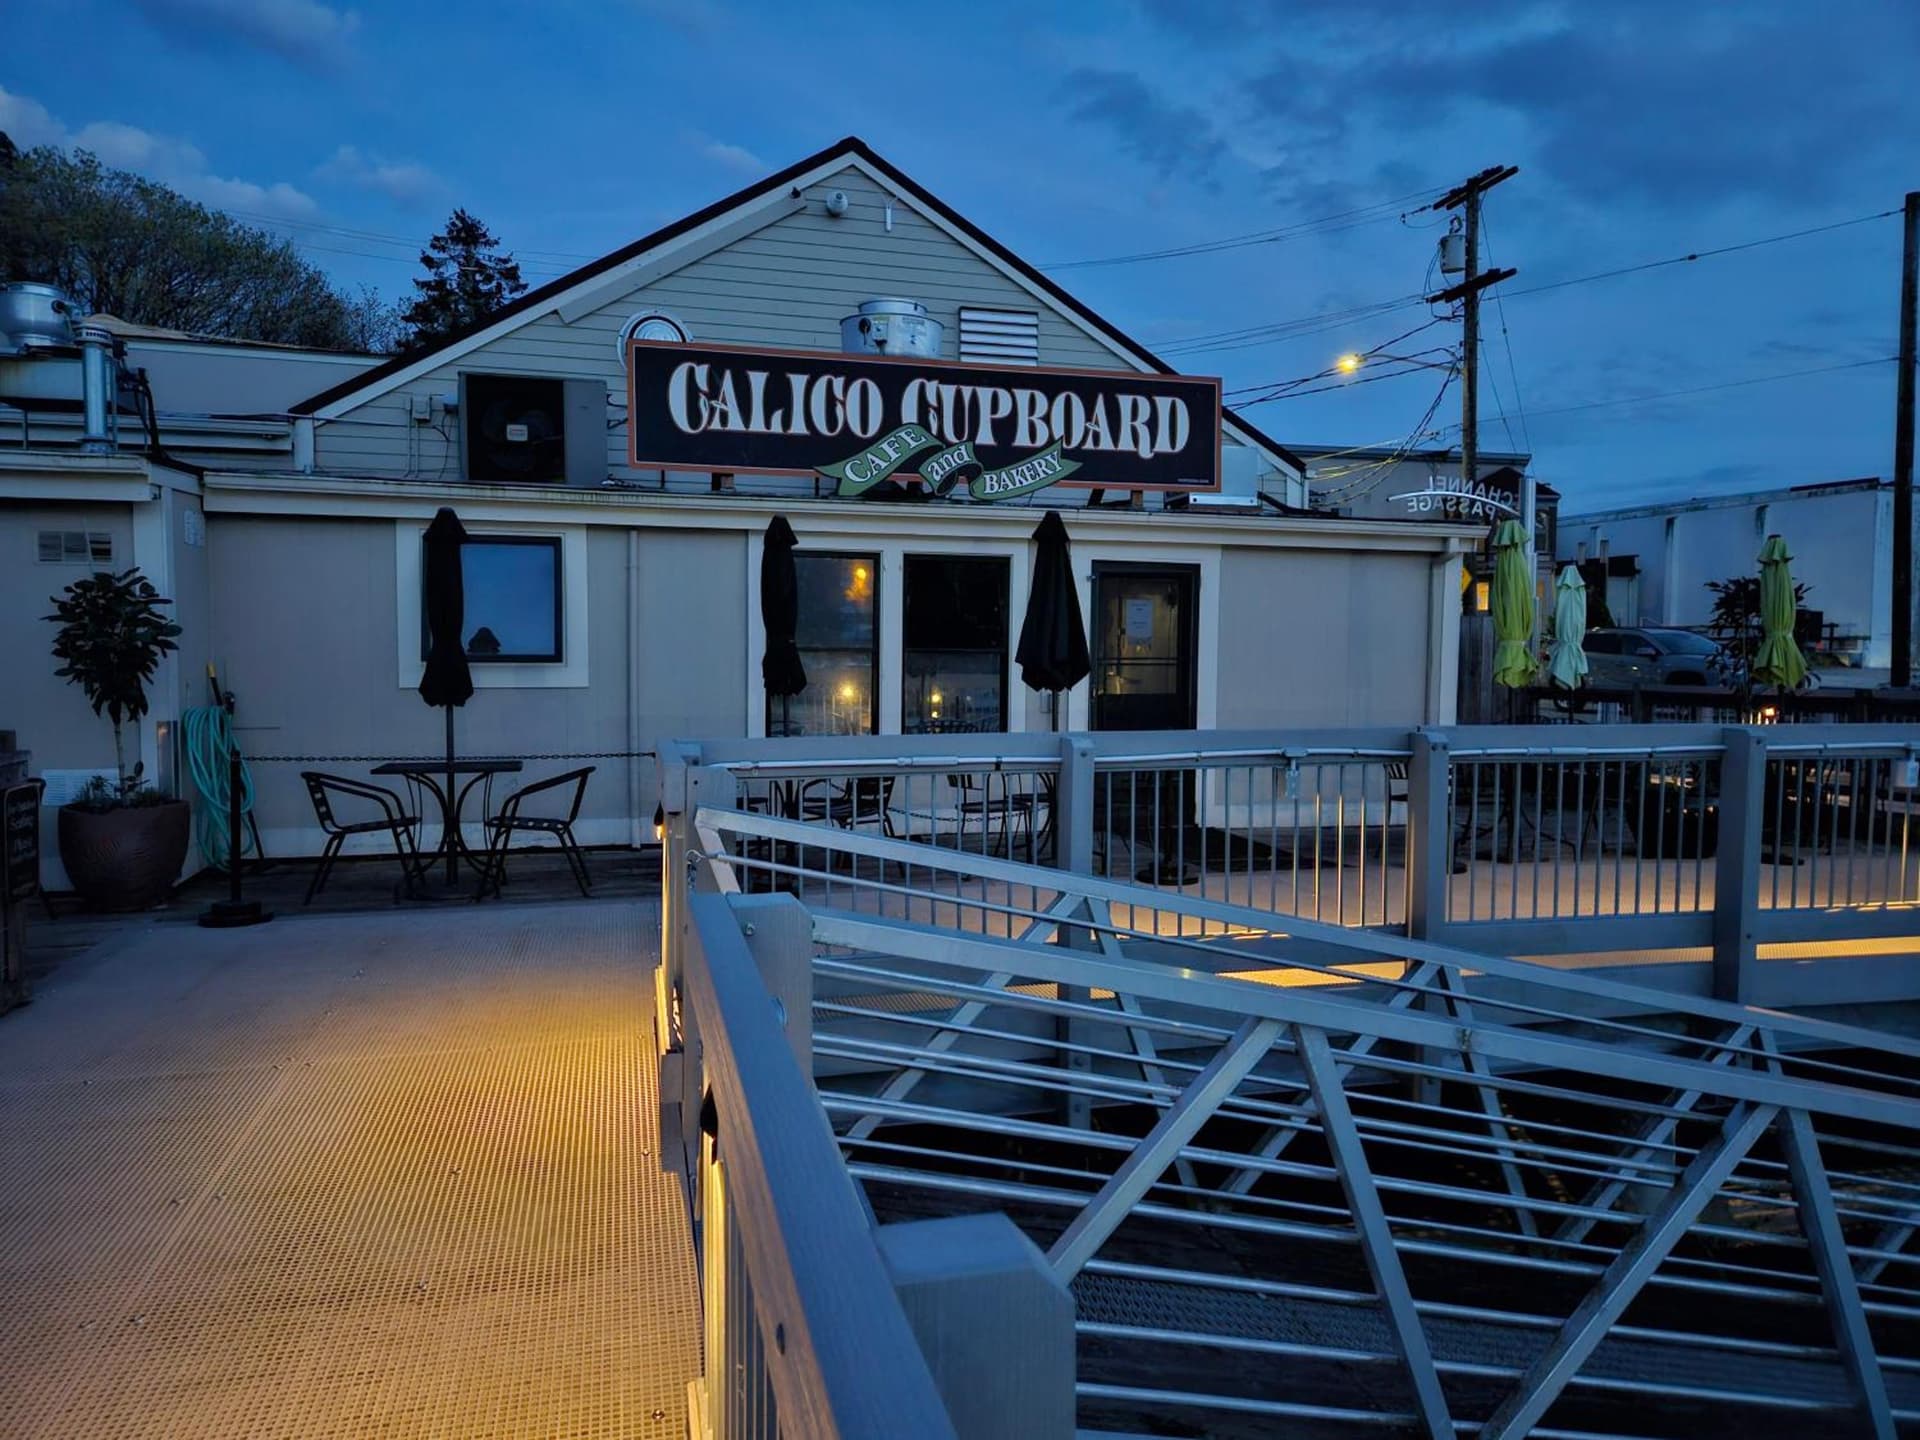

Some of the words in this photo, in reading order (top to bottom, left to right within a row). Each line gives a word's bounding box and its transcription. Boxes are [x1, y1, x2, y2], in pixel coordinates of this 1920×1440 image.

[668, 362, 884, 438] CALICO
[901, 378, 1190, 458] CUPBOARD
[843, 427, 928, 484] CAFE
[927, 446, 972, 481] and
[982, 450, 1063, 495] BAKERY
